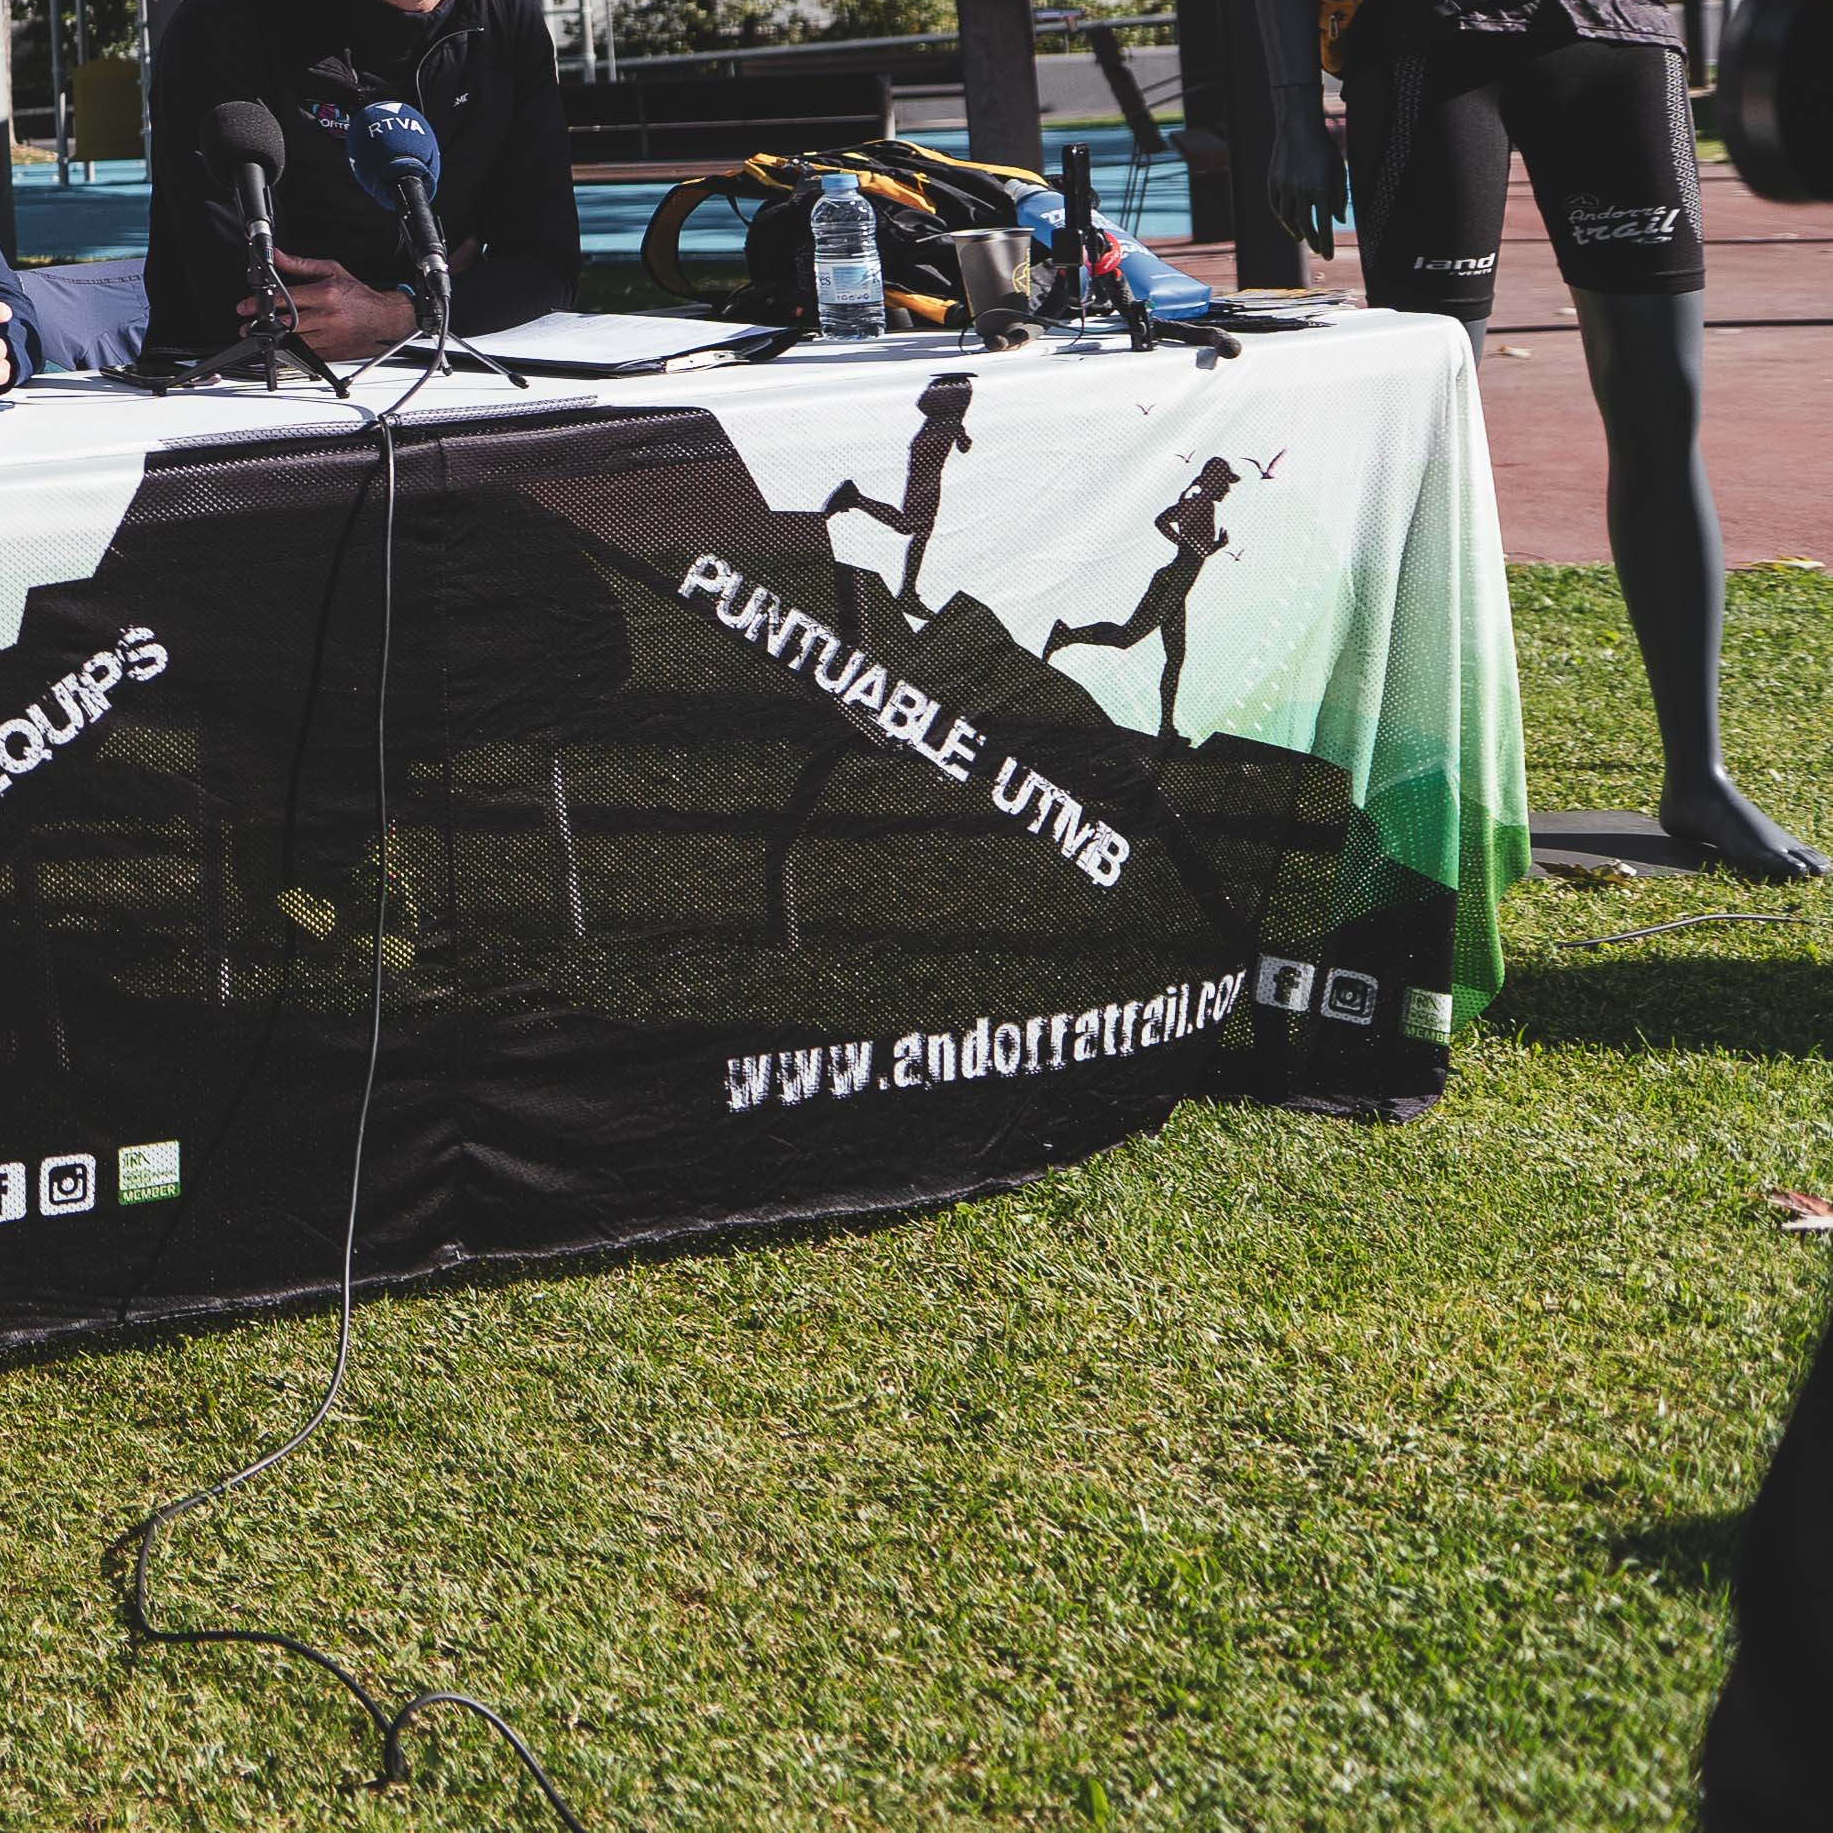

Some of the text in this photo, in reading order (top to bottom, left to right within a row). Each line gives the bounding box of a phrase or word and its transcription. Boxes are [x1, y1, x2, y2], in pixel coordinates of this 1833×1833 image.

[368, 117, 426, 138] RTVA
[1569, 206, 1668, 226] Andorra
[1572, 208, 1681, 245] trail
[678, 552, 1132, 891] PUNTUABLE UTMB
[122, 1183, 177, 1202] MEMBER
